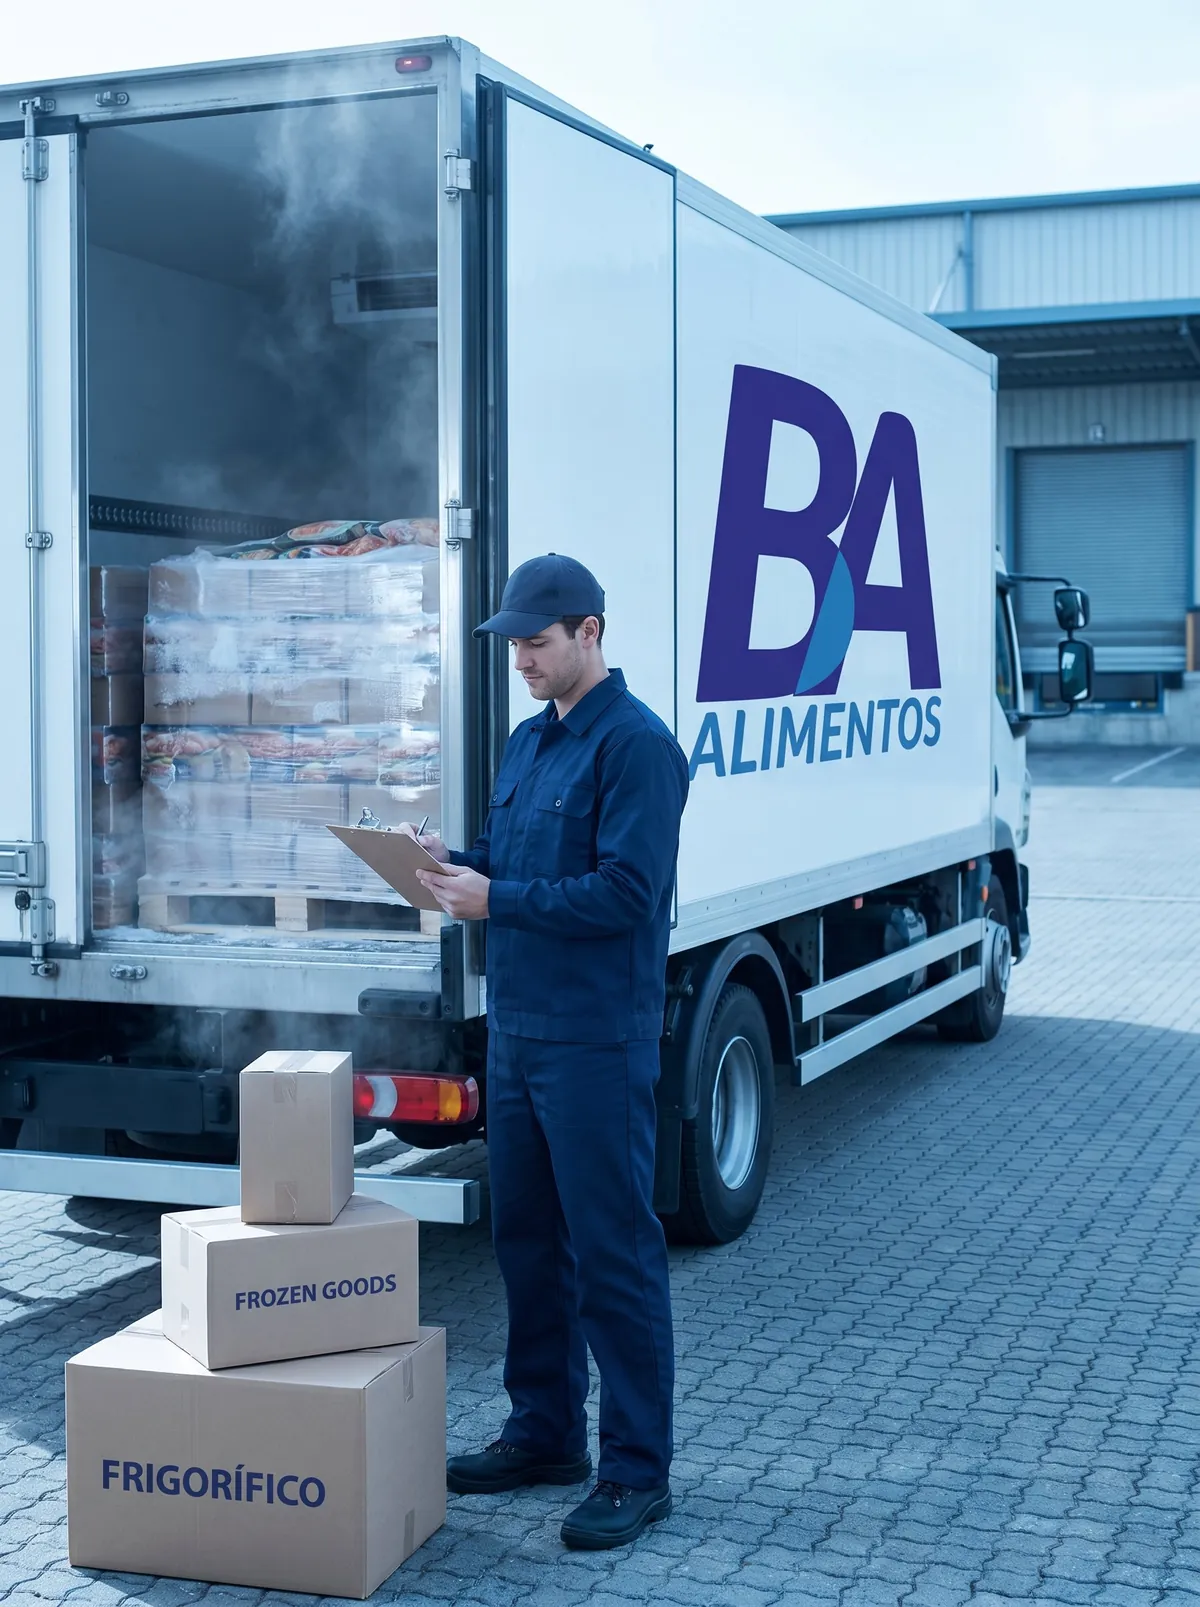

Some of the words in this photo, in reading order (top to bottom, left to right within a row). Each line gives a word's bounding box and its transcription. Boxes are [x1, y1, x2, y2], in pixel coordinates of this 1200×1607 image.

[696, 364, 941, 703] BA
[689, 696, 942, 781] ALIMENTOS
[235, 1282, 317, 1311] FROZEN
[322, 1273, 397, 1301] GOODS
[102, 1459, 326, 1508] FRIGORÍFICO
